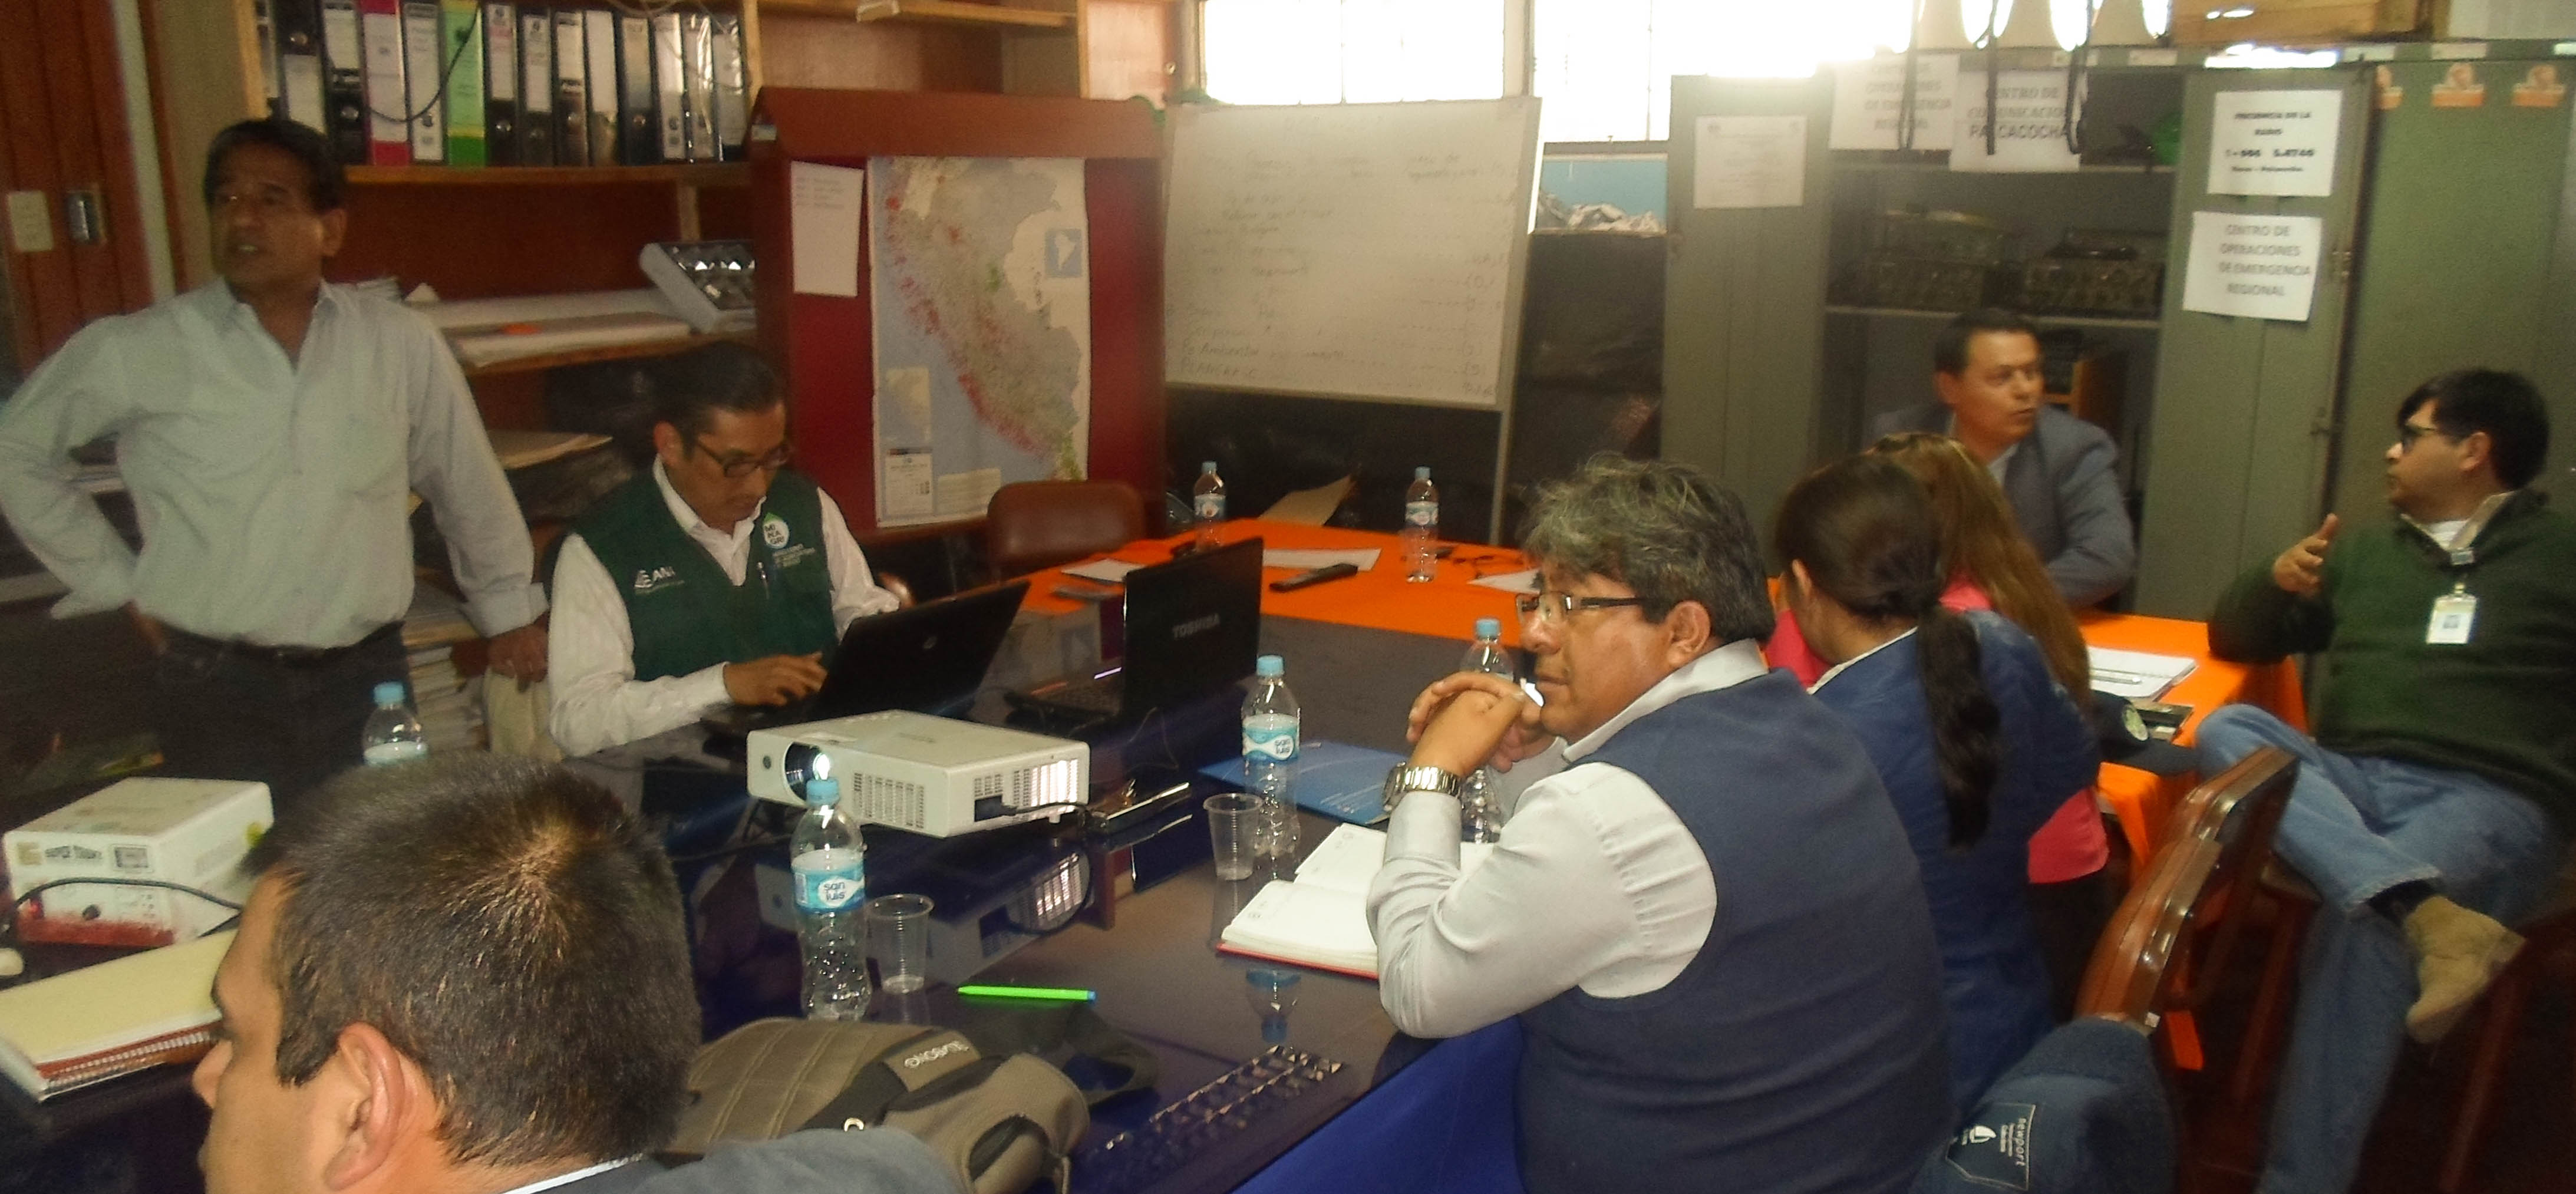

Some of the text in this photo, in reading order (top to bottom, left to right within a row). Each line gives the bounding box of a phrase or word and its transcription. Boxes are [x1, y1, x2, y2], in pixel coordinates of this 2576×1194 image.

[1969, 124, 2070, 139] PACACOCHA
[824, 882, 846, 891] san
[826, 890, 846, 901] luis
